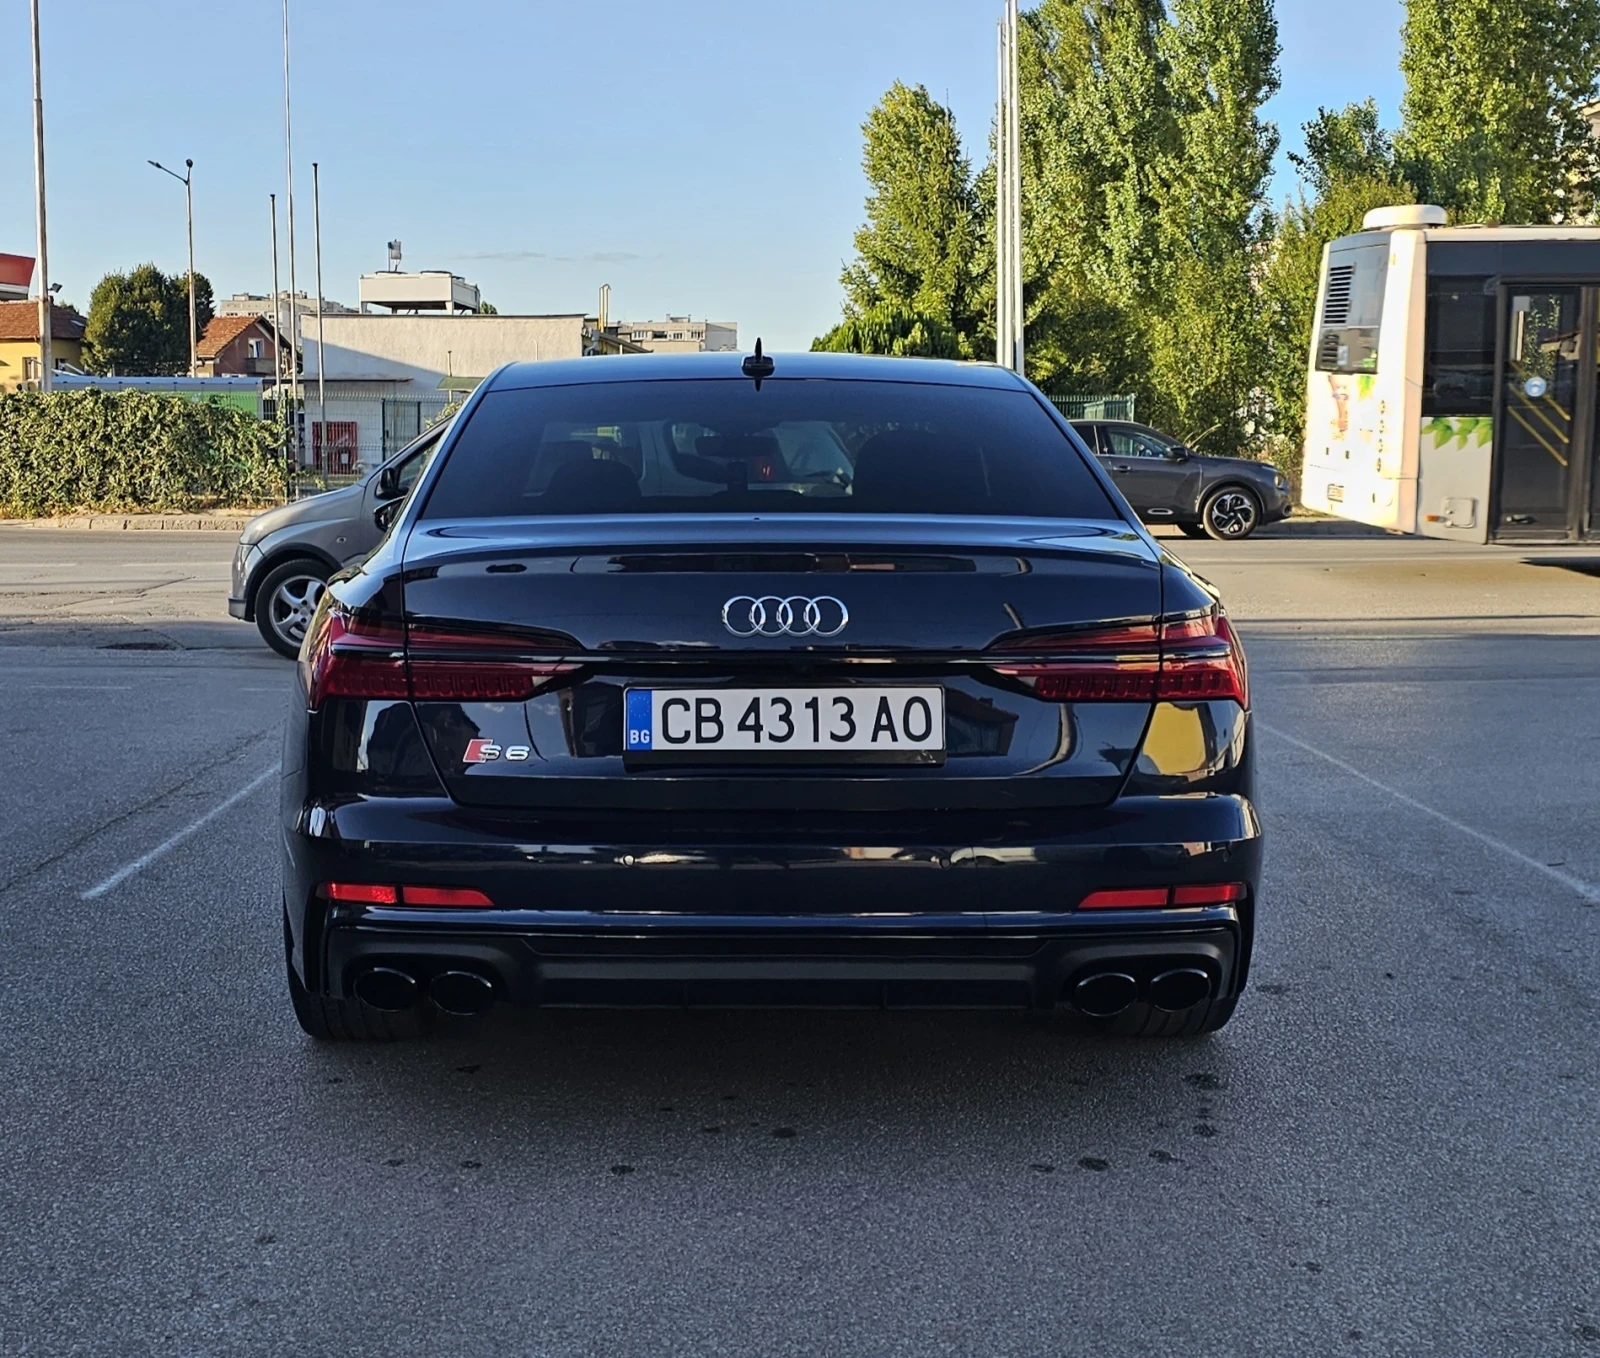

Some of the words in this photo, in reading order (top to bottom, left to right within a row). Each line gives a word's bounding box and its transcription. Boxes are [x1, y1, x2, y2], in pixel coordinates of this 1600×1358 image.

[661, 697, 724, 744] CB
[737, 696, 857, 744] 4313
[630, 729, 650, 744] BG
[478, 744, 532, 761] S6
